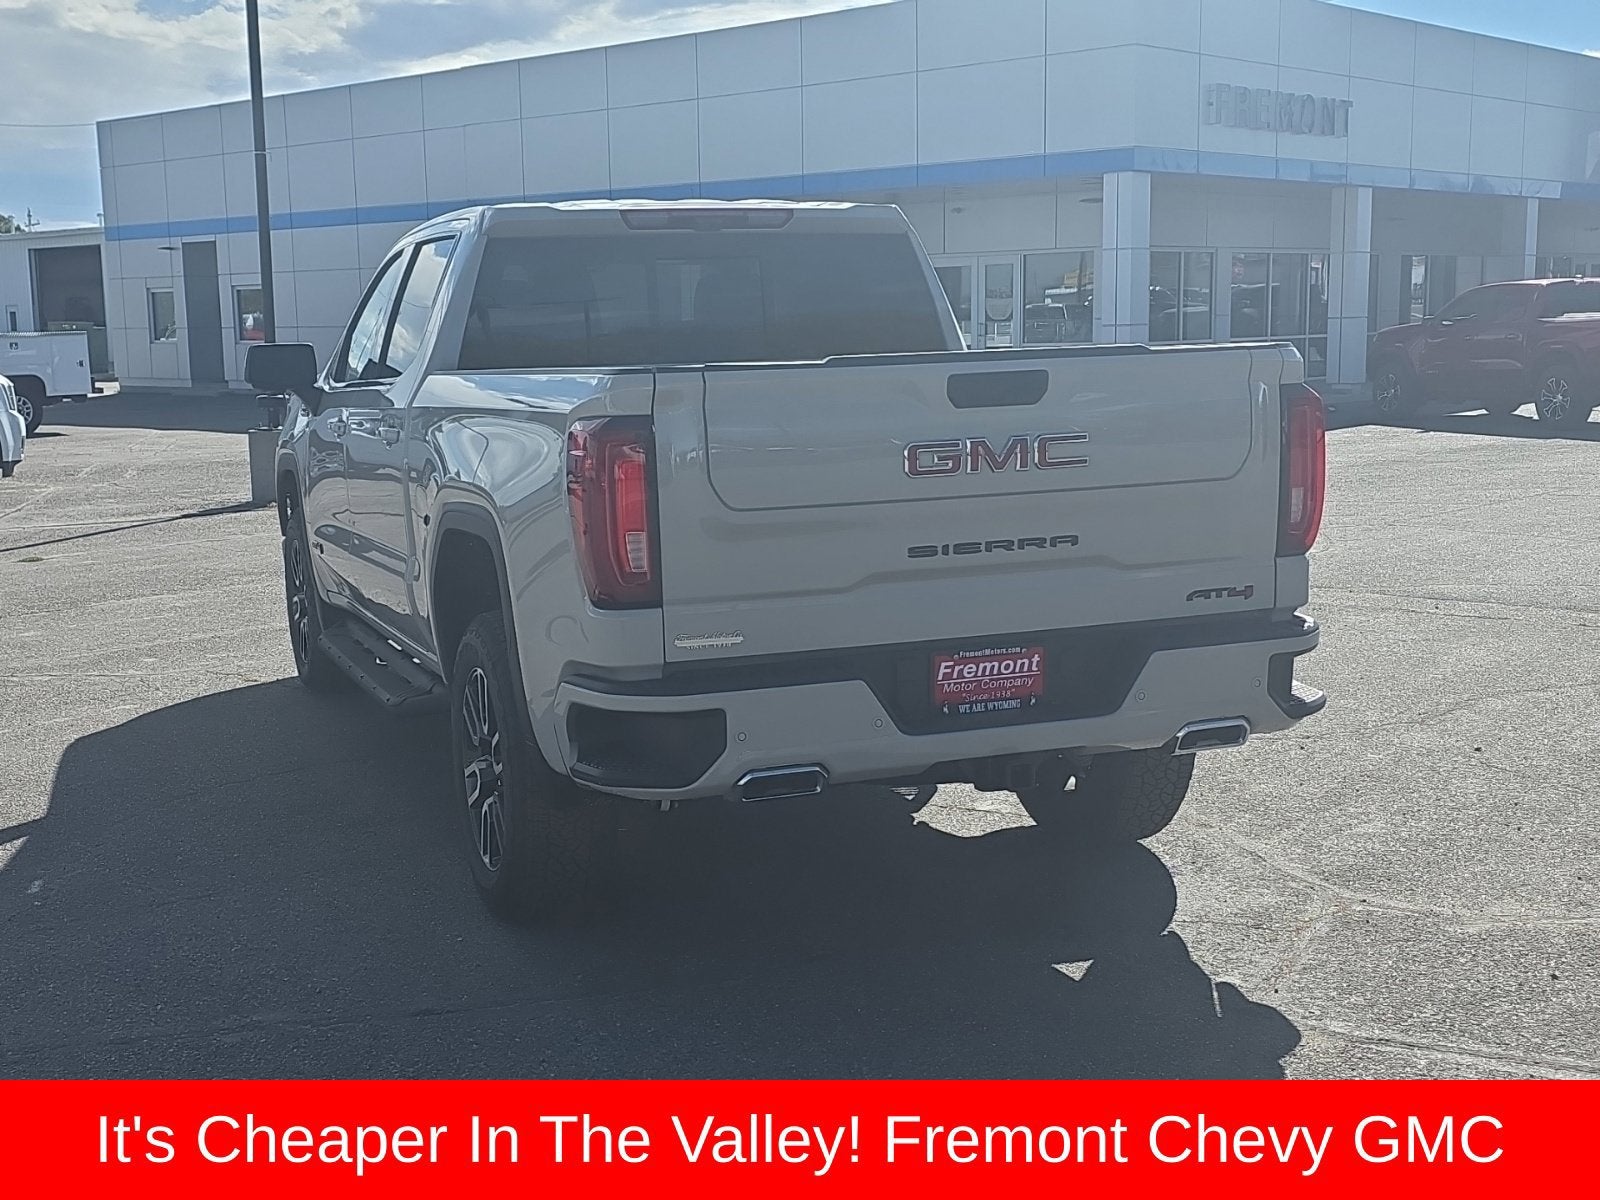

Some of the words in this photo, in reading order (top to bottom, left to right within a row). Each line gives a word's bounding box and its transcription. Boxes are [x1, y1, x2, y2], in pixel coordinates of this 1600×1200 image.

[1204, 83, 1353, 138] FREMONT
[904, 432, 1089, 478] GMC
[907, 534, 1079, 559] SIERRA
[1186, 584, 1254, 602] AT4
[959, 646, 1021, 658] FremontMotors.com
[937, 654, 1041, 681] Fremont
[943, 682, 977, 693] Motor
[981, 677, 1034, 689] Company
[959, 704, 970, 714] WE
[971, 702, 985, 713] ARE
[987, 699, 1021, 711] WYOMING
